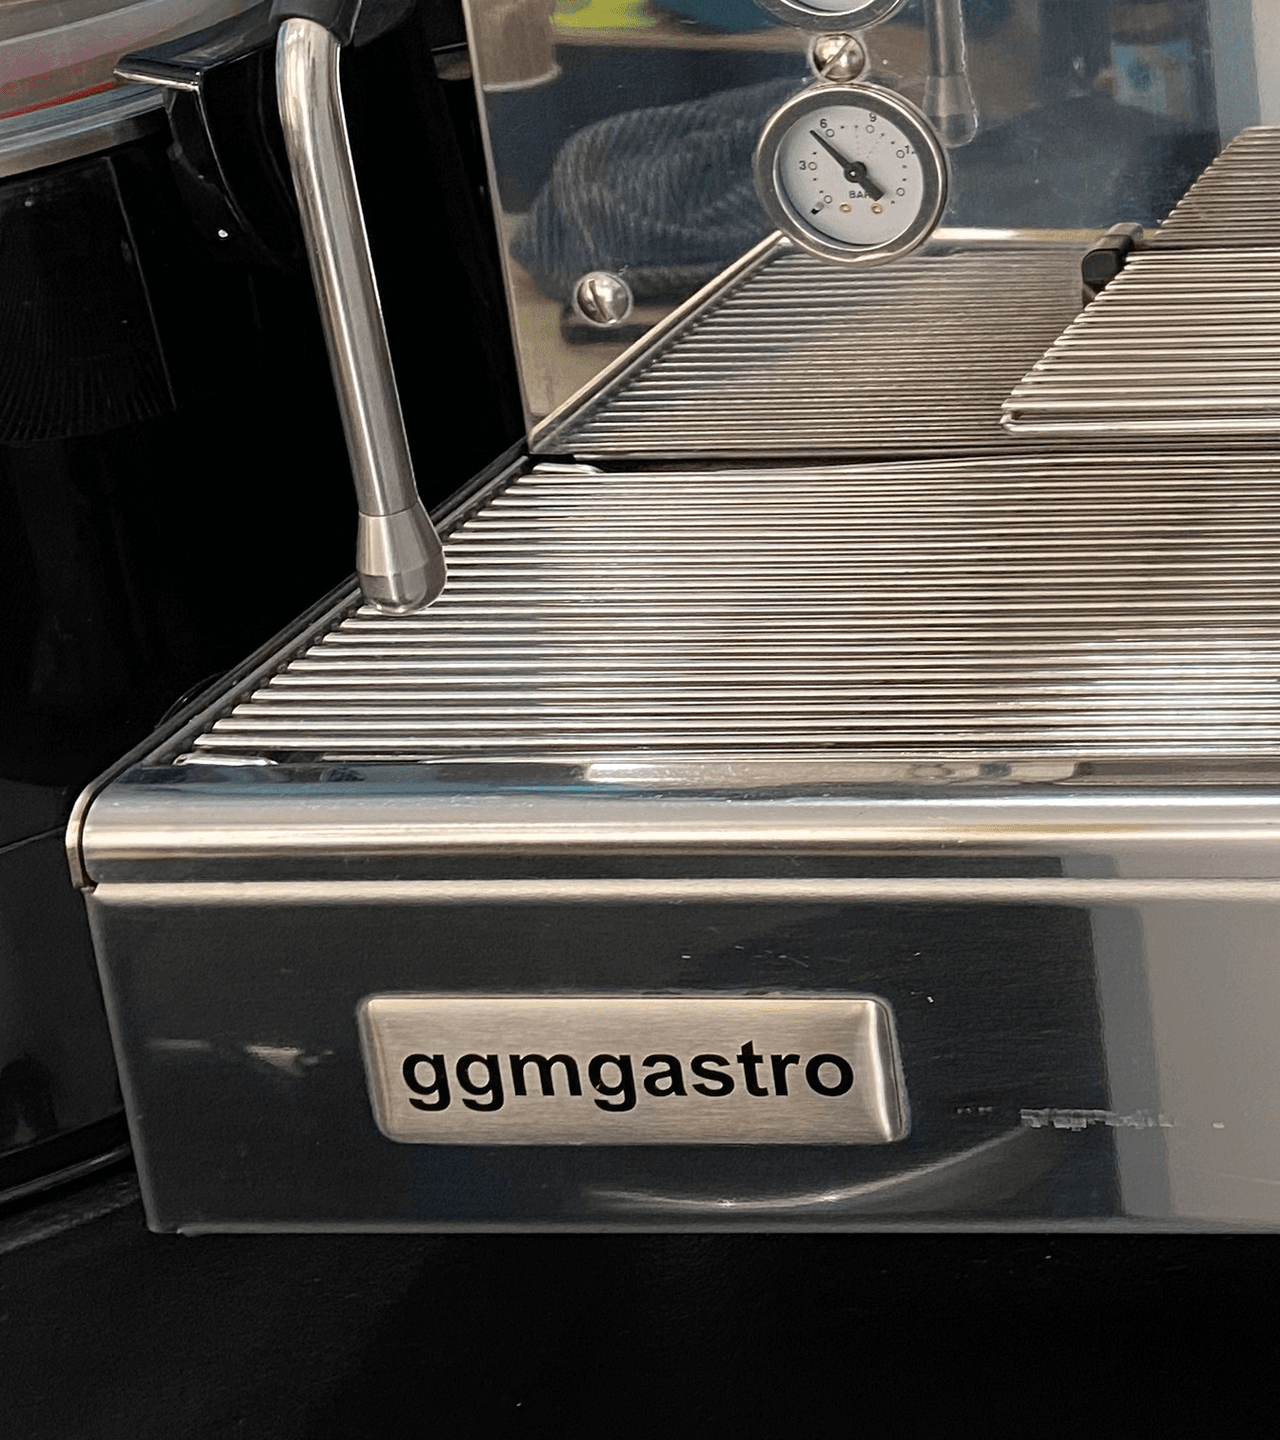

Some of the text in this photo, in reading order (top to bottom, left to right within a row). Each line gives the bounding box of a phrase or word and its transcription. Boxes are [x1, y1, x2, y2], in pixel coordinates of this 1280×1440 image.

[869, 112, 877, 123] 9
[820, 118, 828, 129] 6
[799, 160, 807, 171] 3
[402, 1040, 854, 1112] ggmgastro
